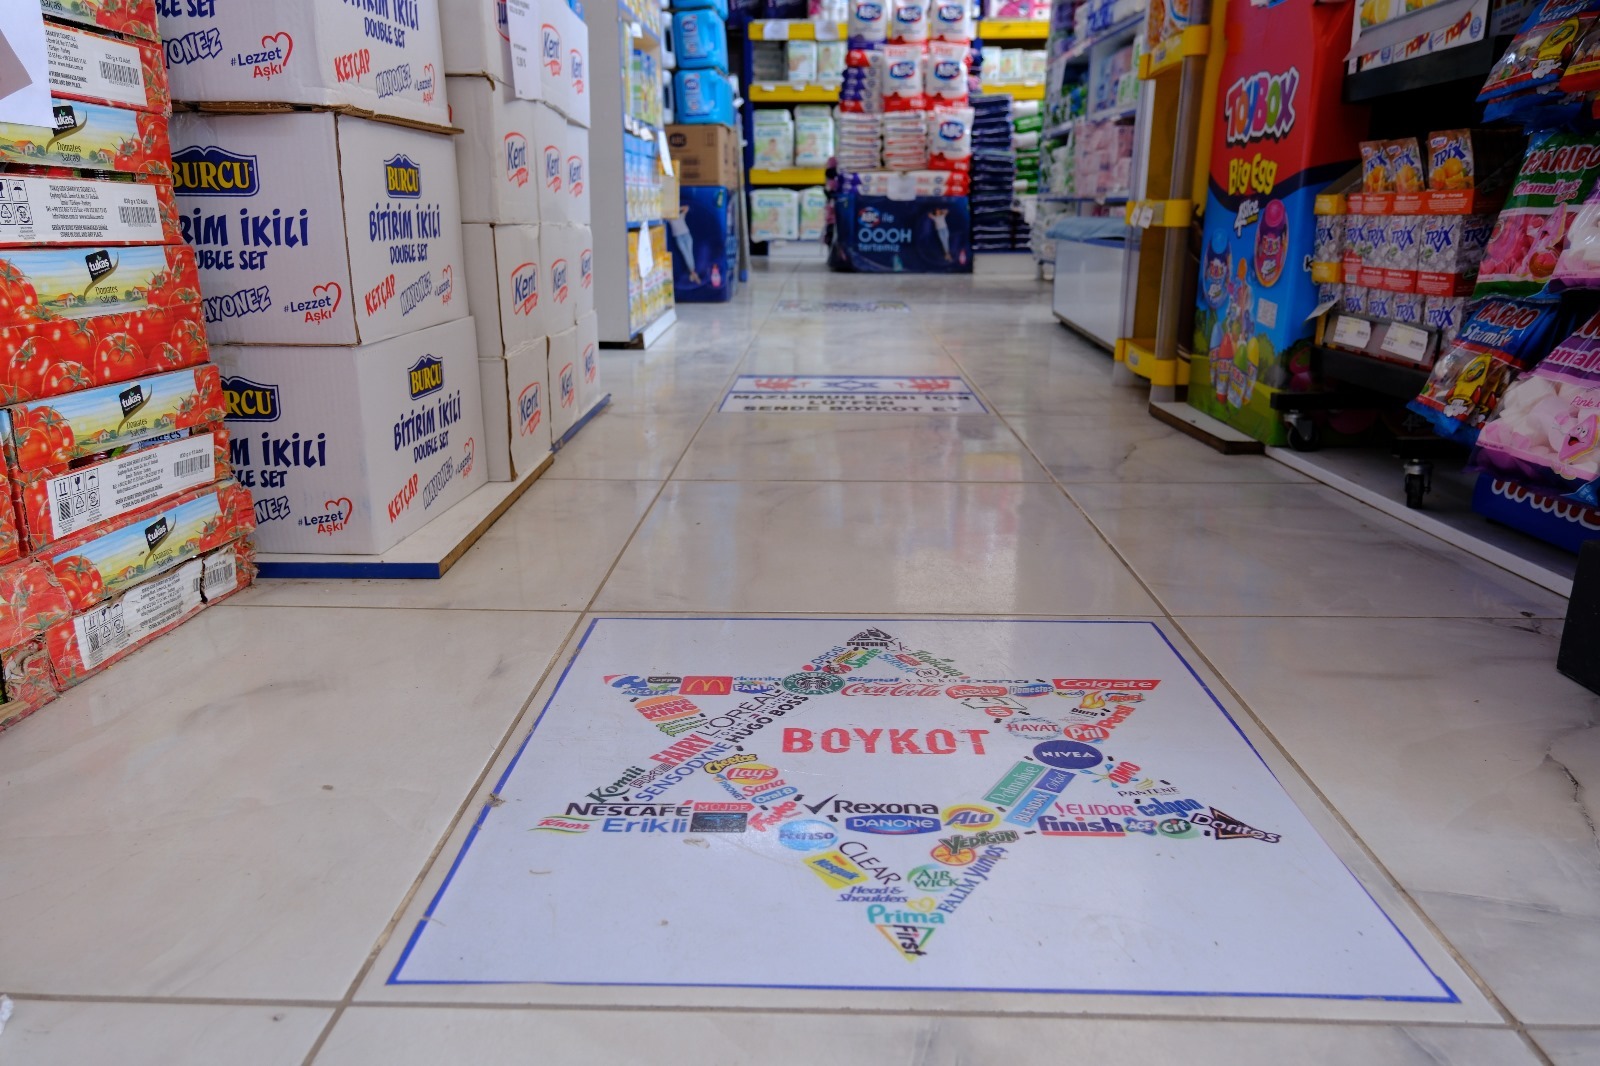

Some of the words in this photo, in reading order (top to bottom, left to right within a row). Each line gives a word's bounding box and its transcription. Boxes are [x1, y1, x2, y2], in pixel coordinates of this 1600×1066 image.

[364, 17, 393, 45] DOUBLE
[394, 30, 406, 48] SET
[230, 47, 282, 66] #Lezzet
[543, 32, 560, 60] Kent
[253, 62, 282, 80] Aşkı
[334, 48, 370, 83] KETÇAP
[376, 63, 412, 99] MAYONEZ
[571, 54, 582, 79] Kent
[1226, 66, 1299, 142] TOYBOX
[507, 141, 526, 171] Kent
[546, 154, 560, 178] Kent
[1519, 144, 1600, 176] HARIBO
[172, 162, 250, 190] BURCU
[386, 166, 418, 194] BURCU
[568, 162, 582, 184] Kent
[1228, 158, 1250, 196] Big
[1251, 152, 1278, 195] Egg
[1513, 178, 1583, 196] Chamallows
[240, 208, 308, 248] İKİLİ
[369, 202, 412, 242] BİTİRİM
[417, 204, 441, 238] İKİLİ
[860, 212, 880, 222] ABC
[858, 228, 912, 244] OOOH
[240, 250, 268, 270] SET
[390, 246, 416, 266] DOUBLE
[416, 244, 428, 262] SET
[580, 255, 591, 278] Kent
[515, 270, 536, 305] Kent
[552, 264, 567, 292] Kent
[284, 296, 332, 313] #Lezzet
[364, 274, 396, 317] KETÇAP
[400, 271, 432, 317] MAYONEZ
[304, 310, 332, 324] Aşkı
[1474, 301, 1540, 330] HARIBO
[1462, 324, 1514, 347] Starmix
[584, 354, 594, 376] Kent
[411, 364, 442, 394] BURCU
[561, 374, 574, 402] Kent
[520, 388, 538, 425] Kent
[394, 410, 436, 452] BİTİRİM
[438, 390, 461, 429] İKİLİ
[262, 432, 326, 468] İKİLİ
[413, 440, 438, 464] DOUBLE
[438, 430, 449, 450] SET
[260, 470, 288, 488] SET
[388, 473, 418, 524] KETÇAP
[298, 510, 344, 526] #Lezzet
[317, 522, 344, 536] Aşkı
[841, 683, 944, 696] Coca-Cola
[1010, 686, 1054, 694] Domestos
[1060, 679, 1153, 690] Colgate
[638, 699, 693, 714] BURGER
[645, 704, 698, 720] KING
[725, 716, 773, 744] HUGO
[768, 695, 809, 716] BOSS
[1005, 723, 1060, 732] HAYAT
[782, 727, 990, 755] BOYKOT
[1068, 727, 1104, 741] Pril
[650, 733, 715, 767] FAIRY
[635, 742, 734, 802] SENSODYNE
[704, 754, 758, 775] Cheetos
[1108, 760, 1142, 785] OMO
[586, 766, 646, 804] Komili
[742, 778, 786, 797] Sana
[1118, 786, 1180, 798] PANTENE
[564, 800, 694, 817] NESCAFÉ
[834, 800, 940, 816] Rexona
[944, 810, 996, 826] ALO
[1014, 790, 1050, 824] BLENDAX
[1066, 804, 1135, 816] ELIDOR
[1137, 797, 1204, 818] calgon
[538, 818, 590, 830] Knorr
[602, 818, 689, 833] Erikli
[852, 818, 934, 828] DANONE
[1038, 816, 1126, 833] finish
[1128, 821, 1152, 831] ACE
[1162, 820, 1189, 834] Cif
[1190, 812, 1282, 844] Doritos
[812, 858, 860, 881] Nesquik
[839, 842, 901, 886] CLEAR
[916, 868, 952, 880] AIR
[850, 886, 892, 896] Head
[914, 878, 966, 888] WICK
[836, 894, 909, 904] Shoulders
[936, 876, 979, 914] FALIM
[867, 904, 946, 924] Prima
[892, 924, 928, 956] First
